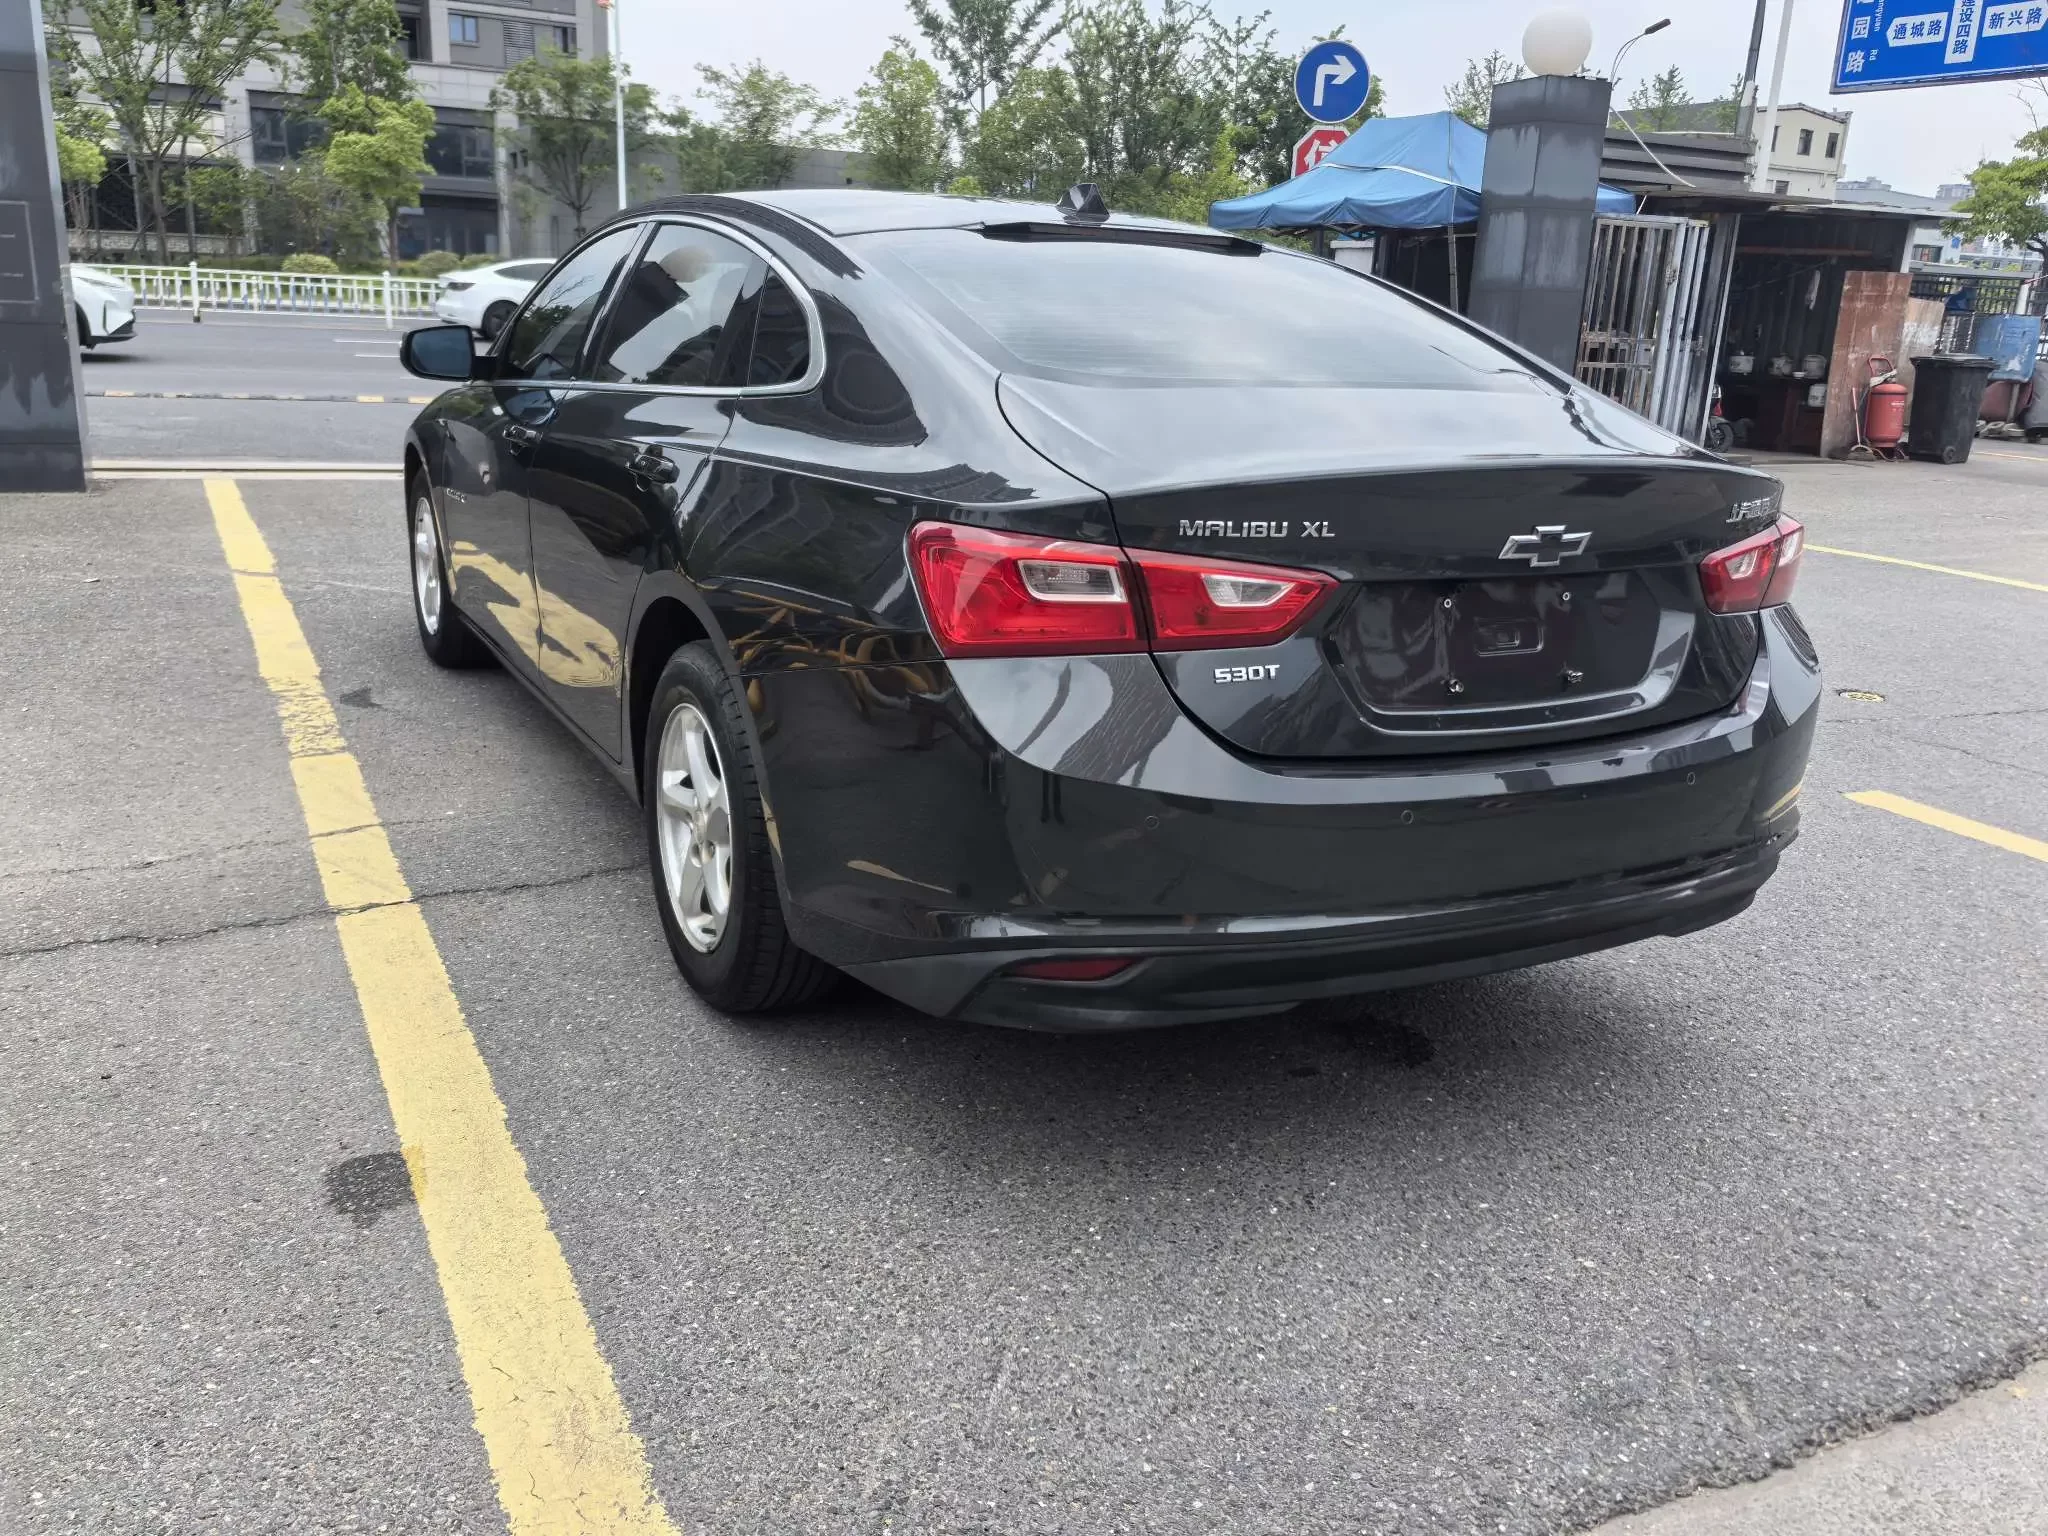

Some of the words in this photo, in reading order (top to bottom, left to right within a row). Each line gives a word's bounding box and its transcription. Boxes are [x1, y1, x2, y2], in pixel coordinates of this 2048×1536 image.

[1988, 7, 2042, 29] 新兴路
[1845, 0, 1875, 72] 园路
[1892, 19, 1942, 40] 通城路
[1179, 519, 1288, 537] MALIBU
[1301, 521, 1335, 538] XL
[1214, 664, 1280, 683] 530T
